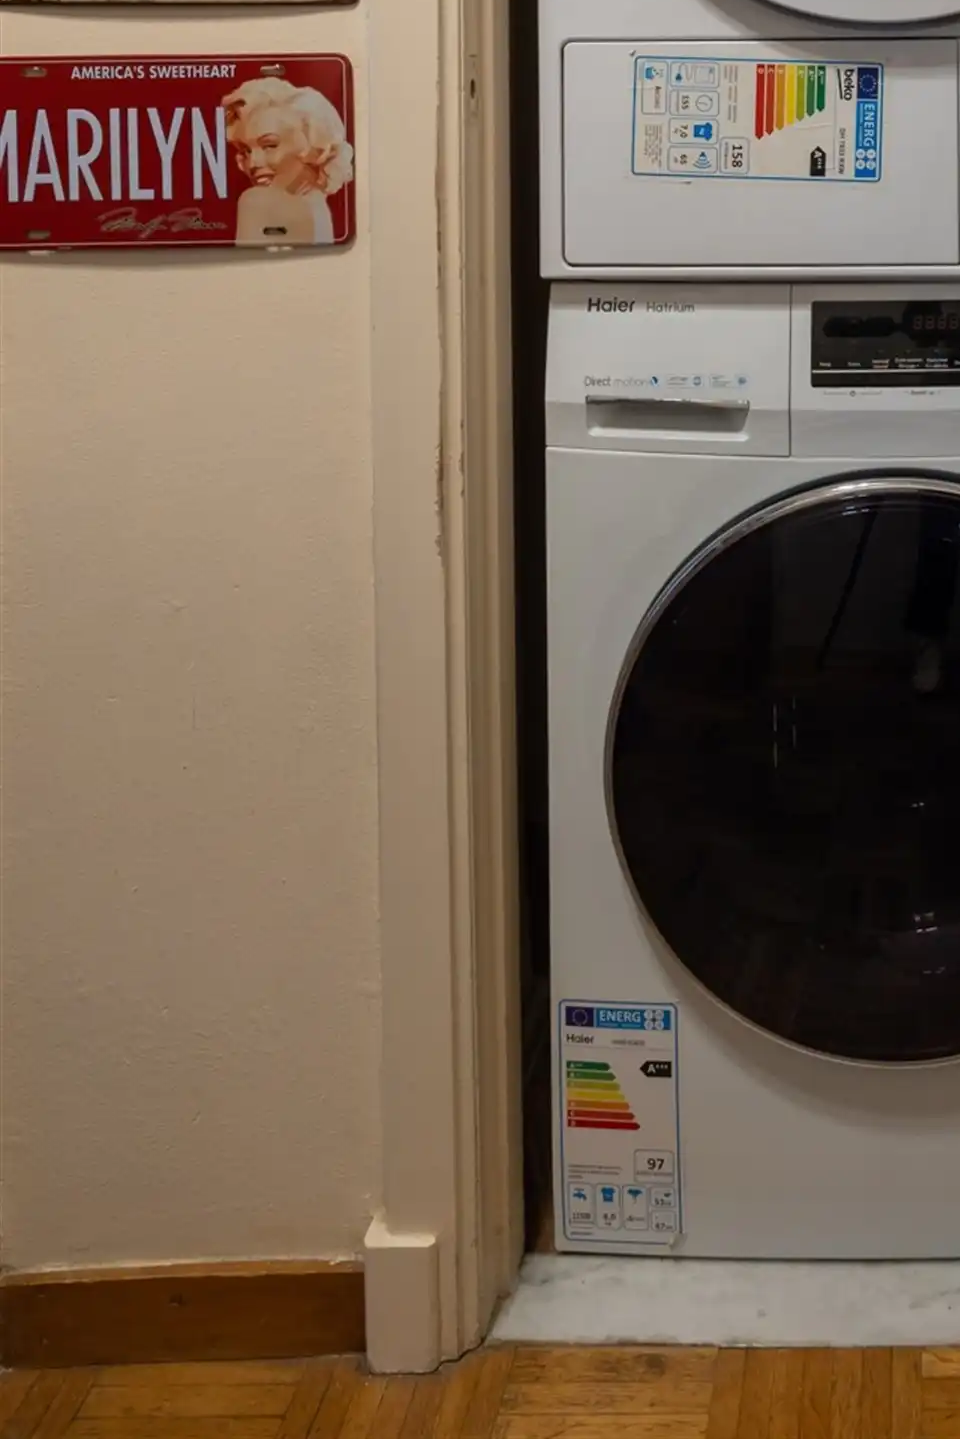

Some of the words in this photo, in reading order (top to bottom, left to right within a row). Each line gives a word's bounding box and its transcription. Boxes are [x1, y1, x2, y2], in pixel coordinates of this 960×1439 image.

[71, 65, 145, 80] AMERICA'S
[149, 64, 237, 79] SWEETHEART
[842, 68, 855, 101] beko
[863, 103, 876, 147] ENERG
[731, 143, 743, 168] 158
[587, 296, 636, 313] Haier
[646, 300, 695, 313] Hatrium
[599, 1009, 641, 1023] ENERG
[566, 1032, 595, 1045] Haier
[646, 1157, 665, 1172] 97
